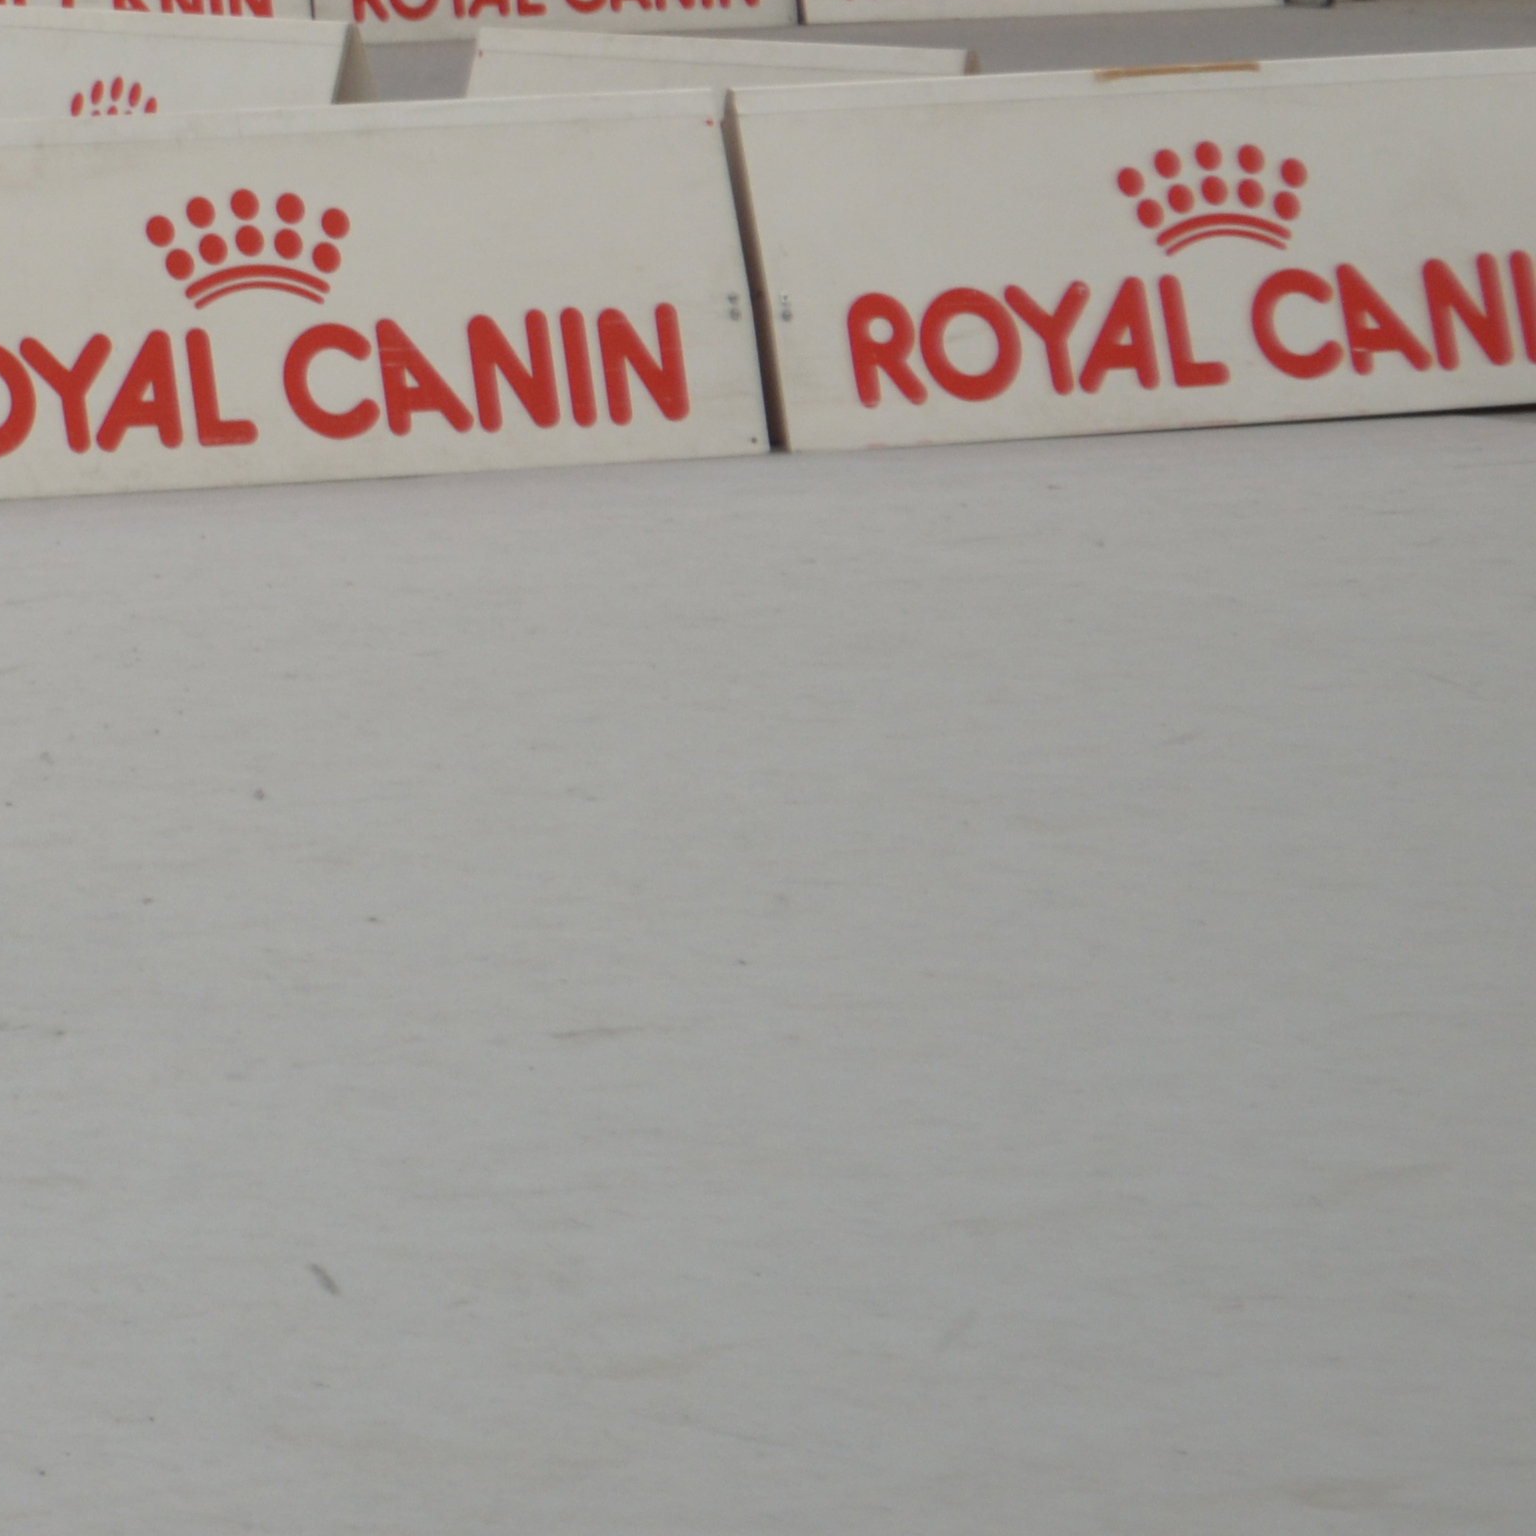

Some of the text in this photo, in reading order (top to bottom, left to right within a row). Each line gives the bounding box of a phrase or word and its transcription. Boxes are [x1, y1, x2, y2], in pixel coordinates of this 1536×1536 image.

[281, 302, 690, 440] CANIN
[846, 250, 1536, 409] ROYAL CANI
